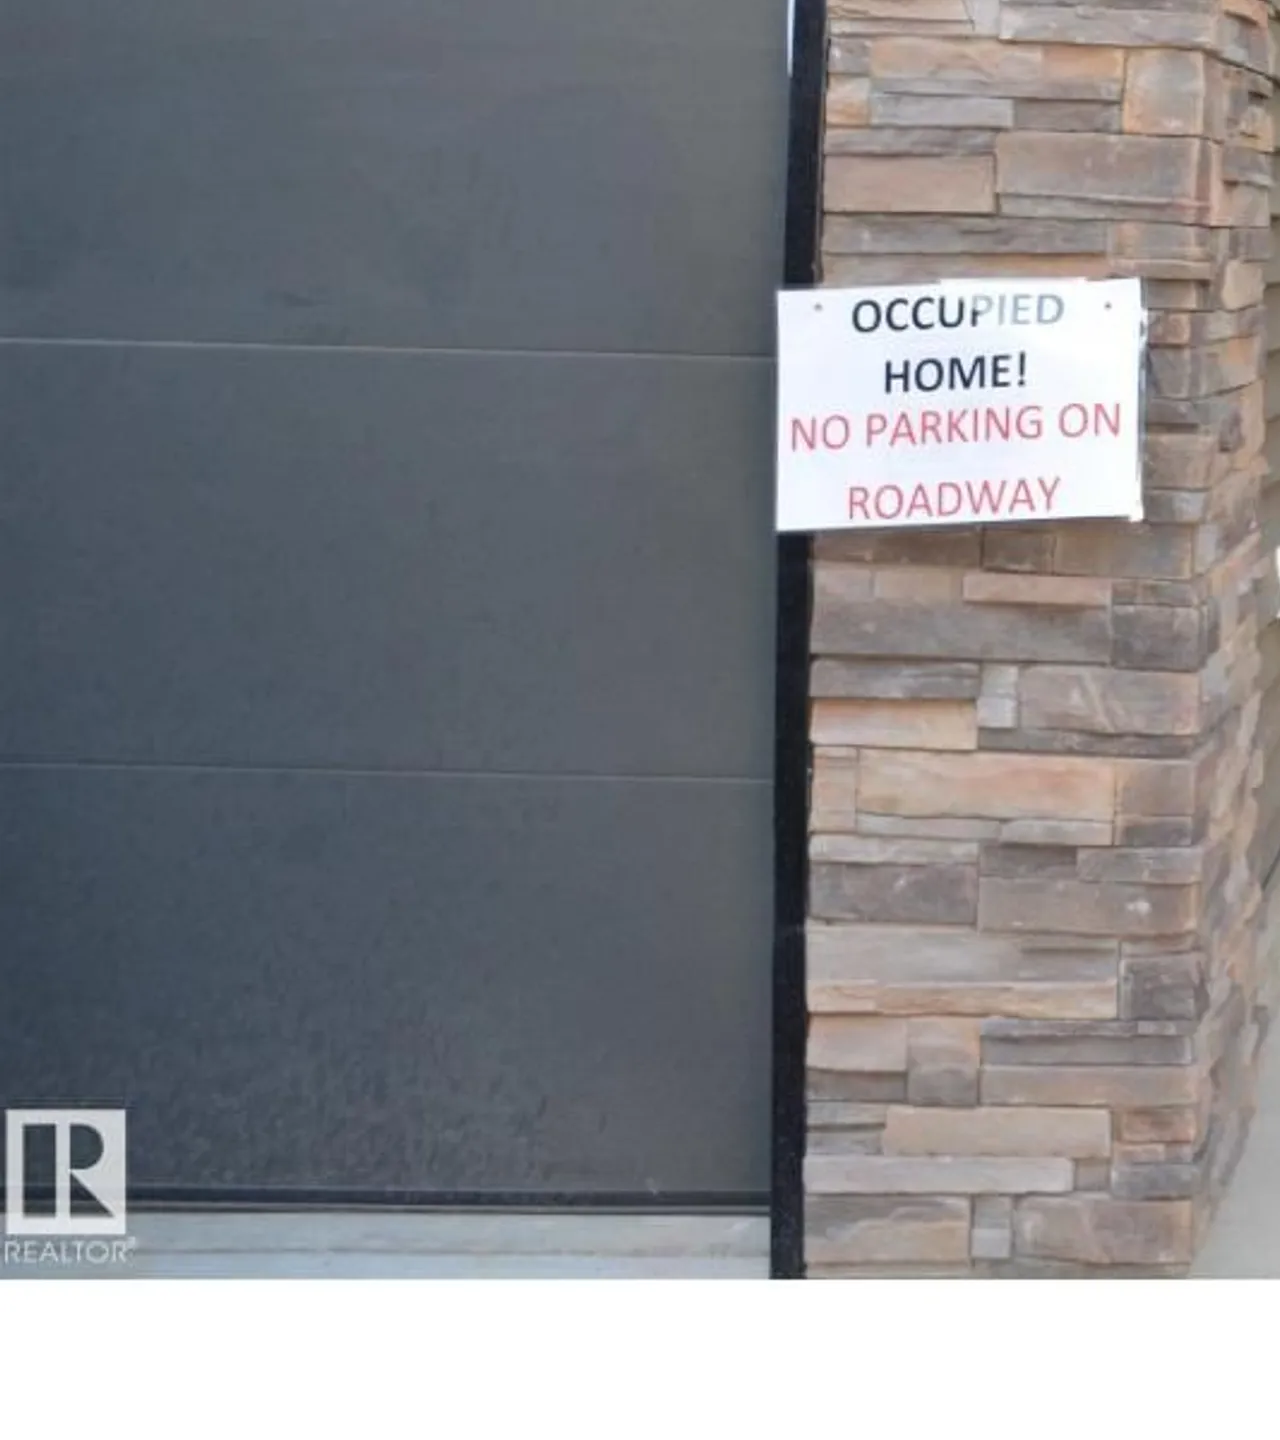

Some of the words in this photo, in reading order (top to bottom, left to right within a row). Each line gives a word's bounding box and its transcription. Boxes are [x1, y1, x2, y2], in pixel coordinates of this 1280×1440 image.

[851, 293, 1066, 333] OCCUPIED
[883, 351, 1027, 394] HOME!
[790, 414, 851, 452] NO
[866, 404, 1044, 448] PARKING
[1058, 402, 1122, 440] ON
[847, 475, 1063, 521] ROADWAY
